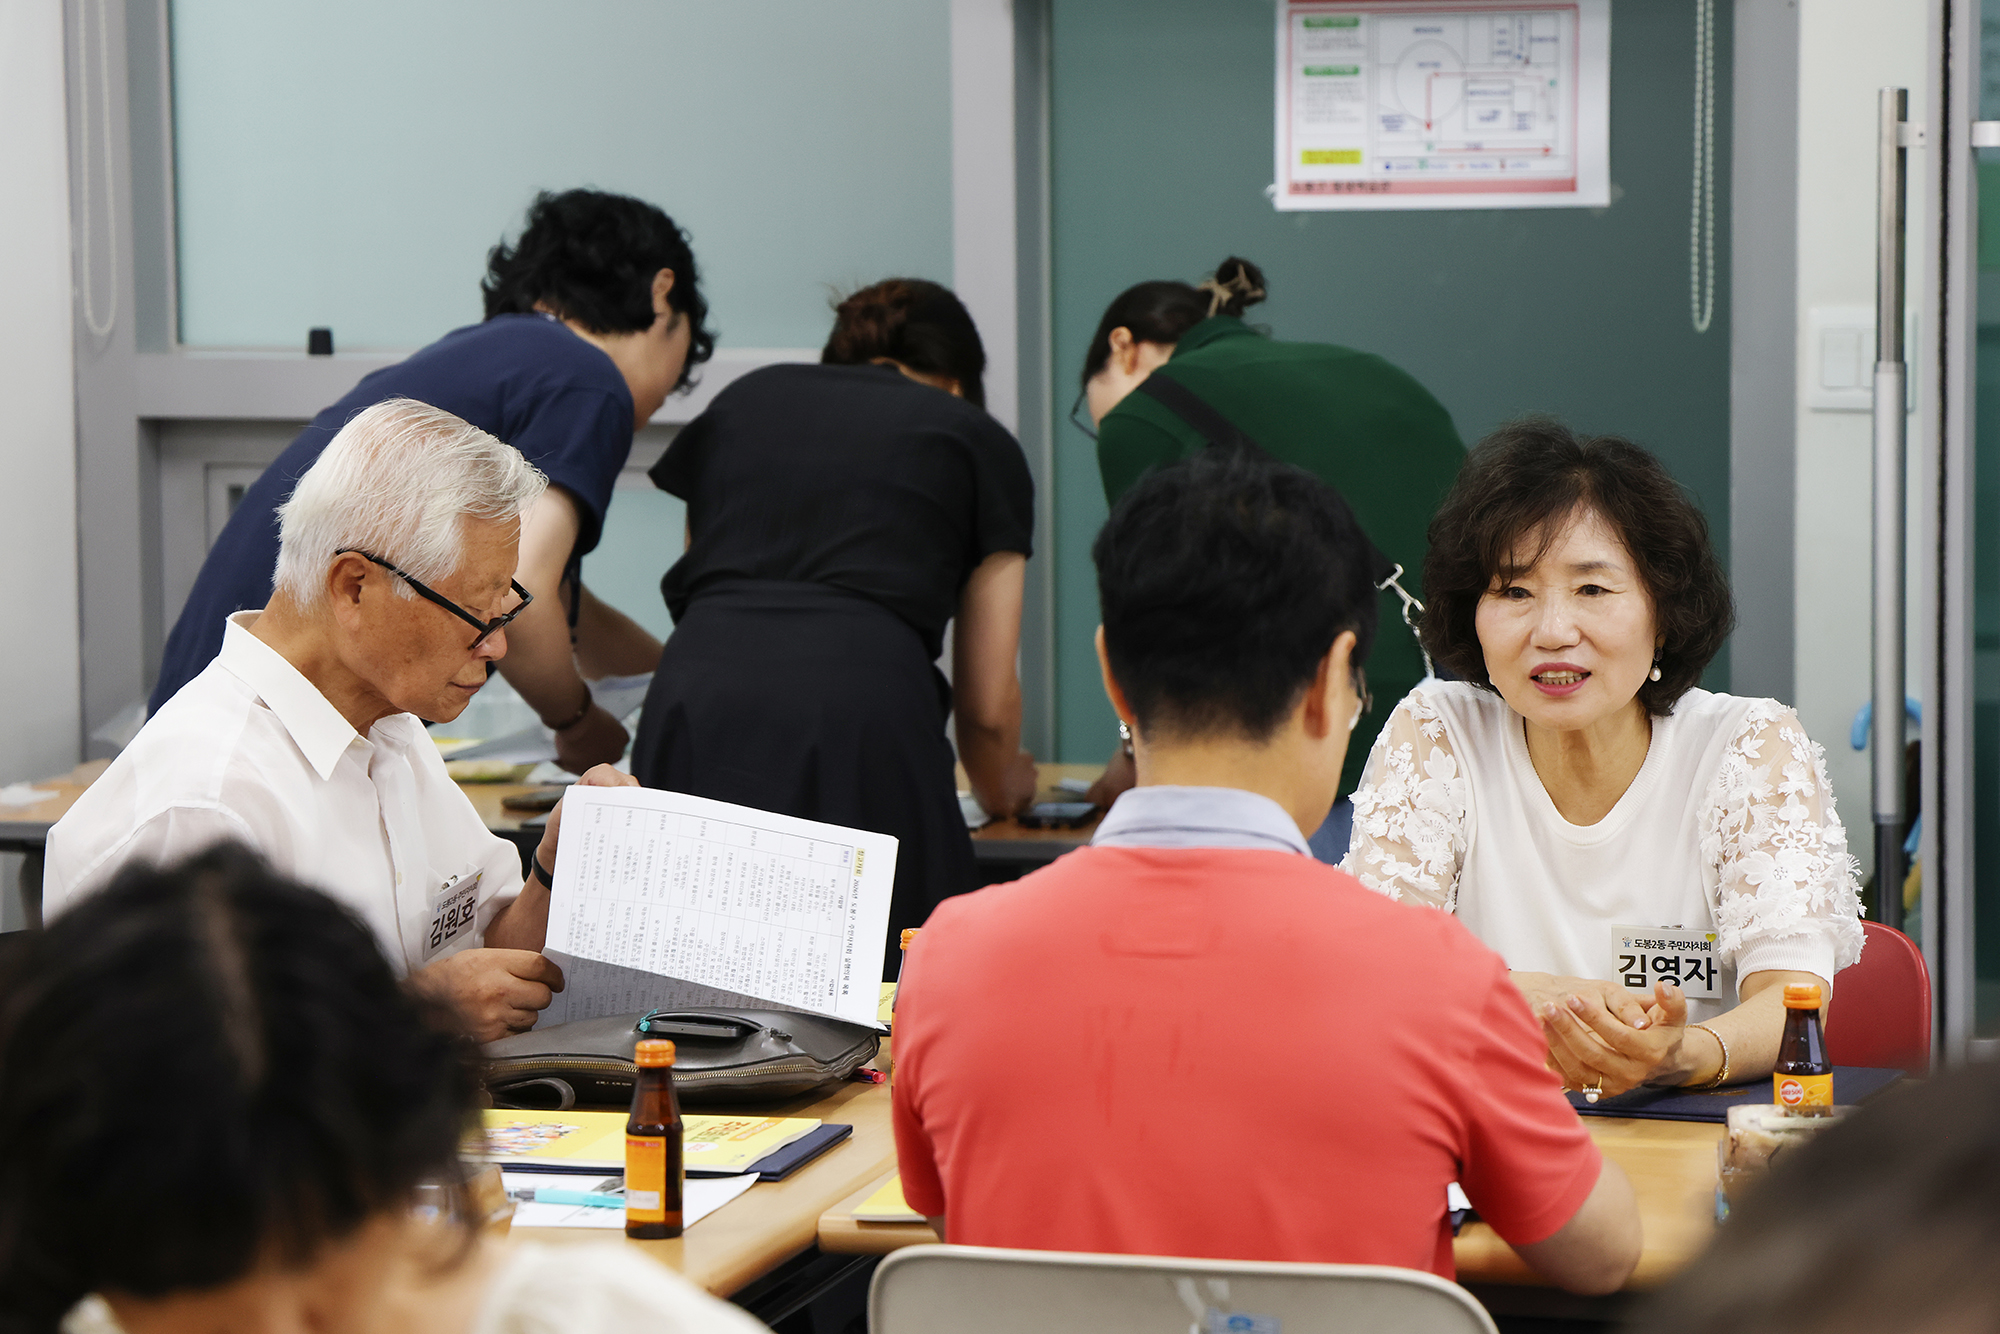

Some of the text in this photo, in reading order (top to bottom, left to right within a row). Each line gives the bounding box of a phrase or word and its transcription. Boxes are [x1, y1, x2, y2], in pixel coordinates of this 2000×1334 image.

[855, 850, 864, 874] 참고자료
[430, 896, 476, 949] 김원호
[845, 924, 854, 954] 주민자치회
[1634, 939, 1712, 952] 도봉2동 주민자치회
[842, 958, 851, 980] 실행의제
[1618, 954, 1718, 991] 김영자
[842, 984, 848, 994] 목록
